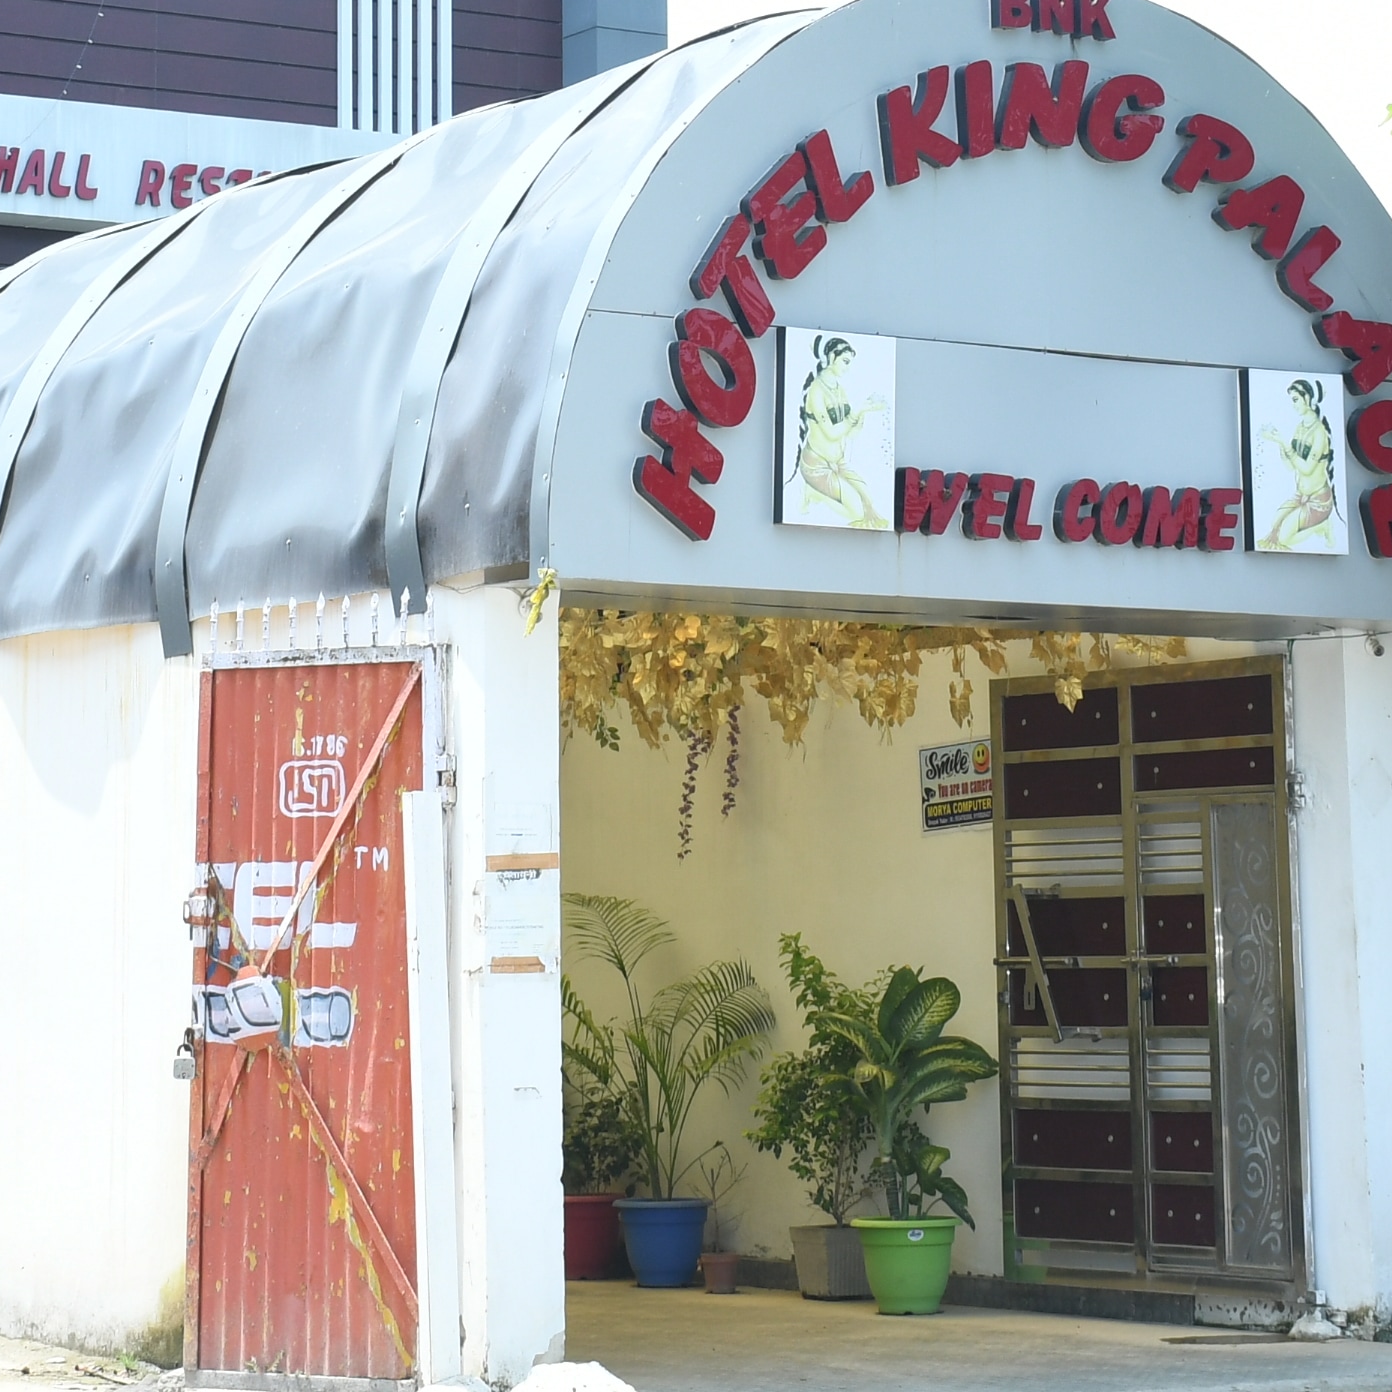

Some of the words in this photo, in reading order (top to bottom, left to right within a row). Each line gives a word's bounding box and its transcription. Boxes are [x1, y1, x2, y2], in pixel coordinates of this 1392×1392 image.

[632, 129, 874, 542] HOTEL
[877, 60, 1166, 187] KING
[925, 749, 969, 780] Smile
[938, 783, 948, 798] You
[950, 783, 960, 796] are
[962, 782, 968, 794] on
[970, 779, 992, 793] camera
[928, 804, 951, 817] MORYA
[953, 798, 992, 813] COMPUTER
[354, 846, 389, 871] TM
